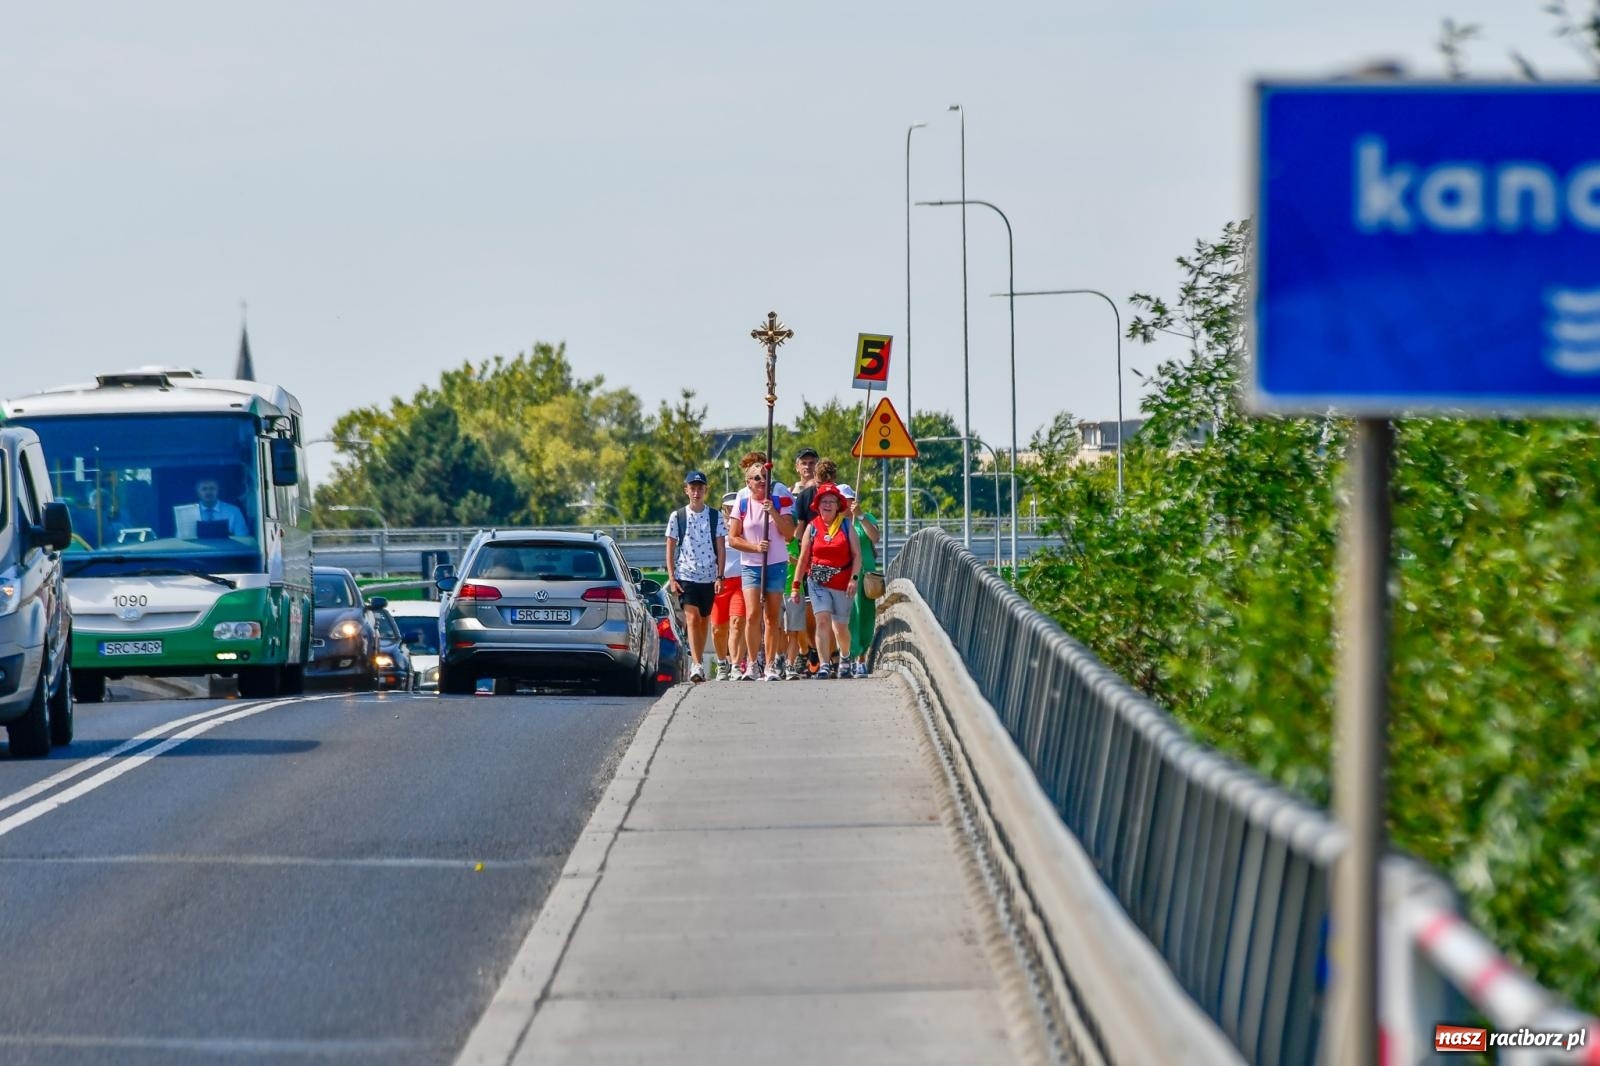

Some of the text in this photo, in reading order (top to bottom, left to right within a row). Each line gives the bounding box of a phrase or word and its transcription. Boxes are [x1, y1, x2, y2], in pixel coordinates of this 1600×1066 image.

[860, 339, 885, 376] 5
[112, 594, 148, 607] 1090
[518, 609, 570, 621] SRC 3TE3
[106, 642, 130, 654] SRC
